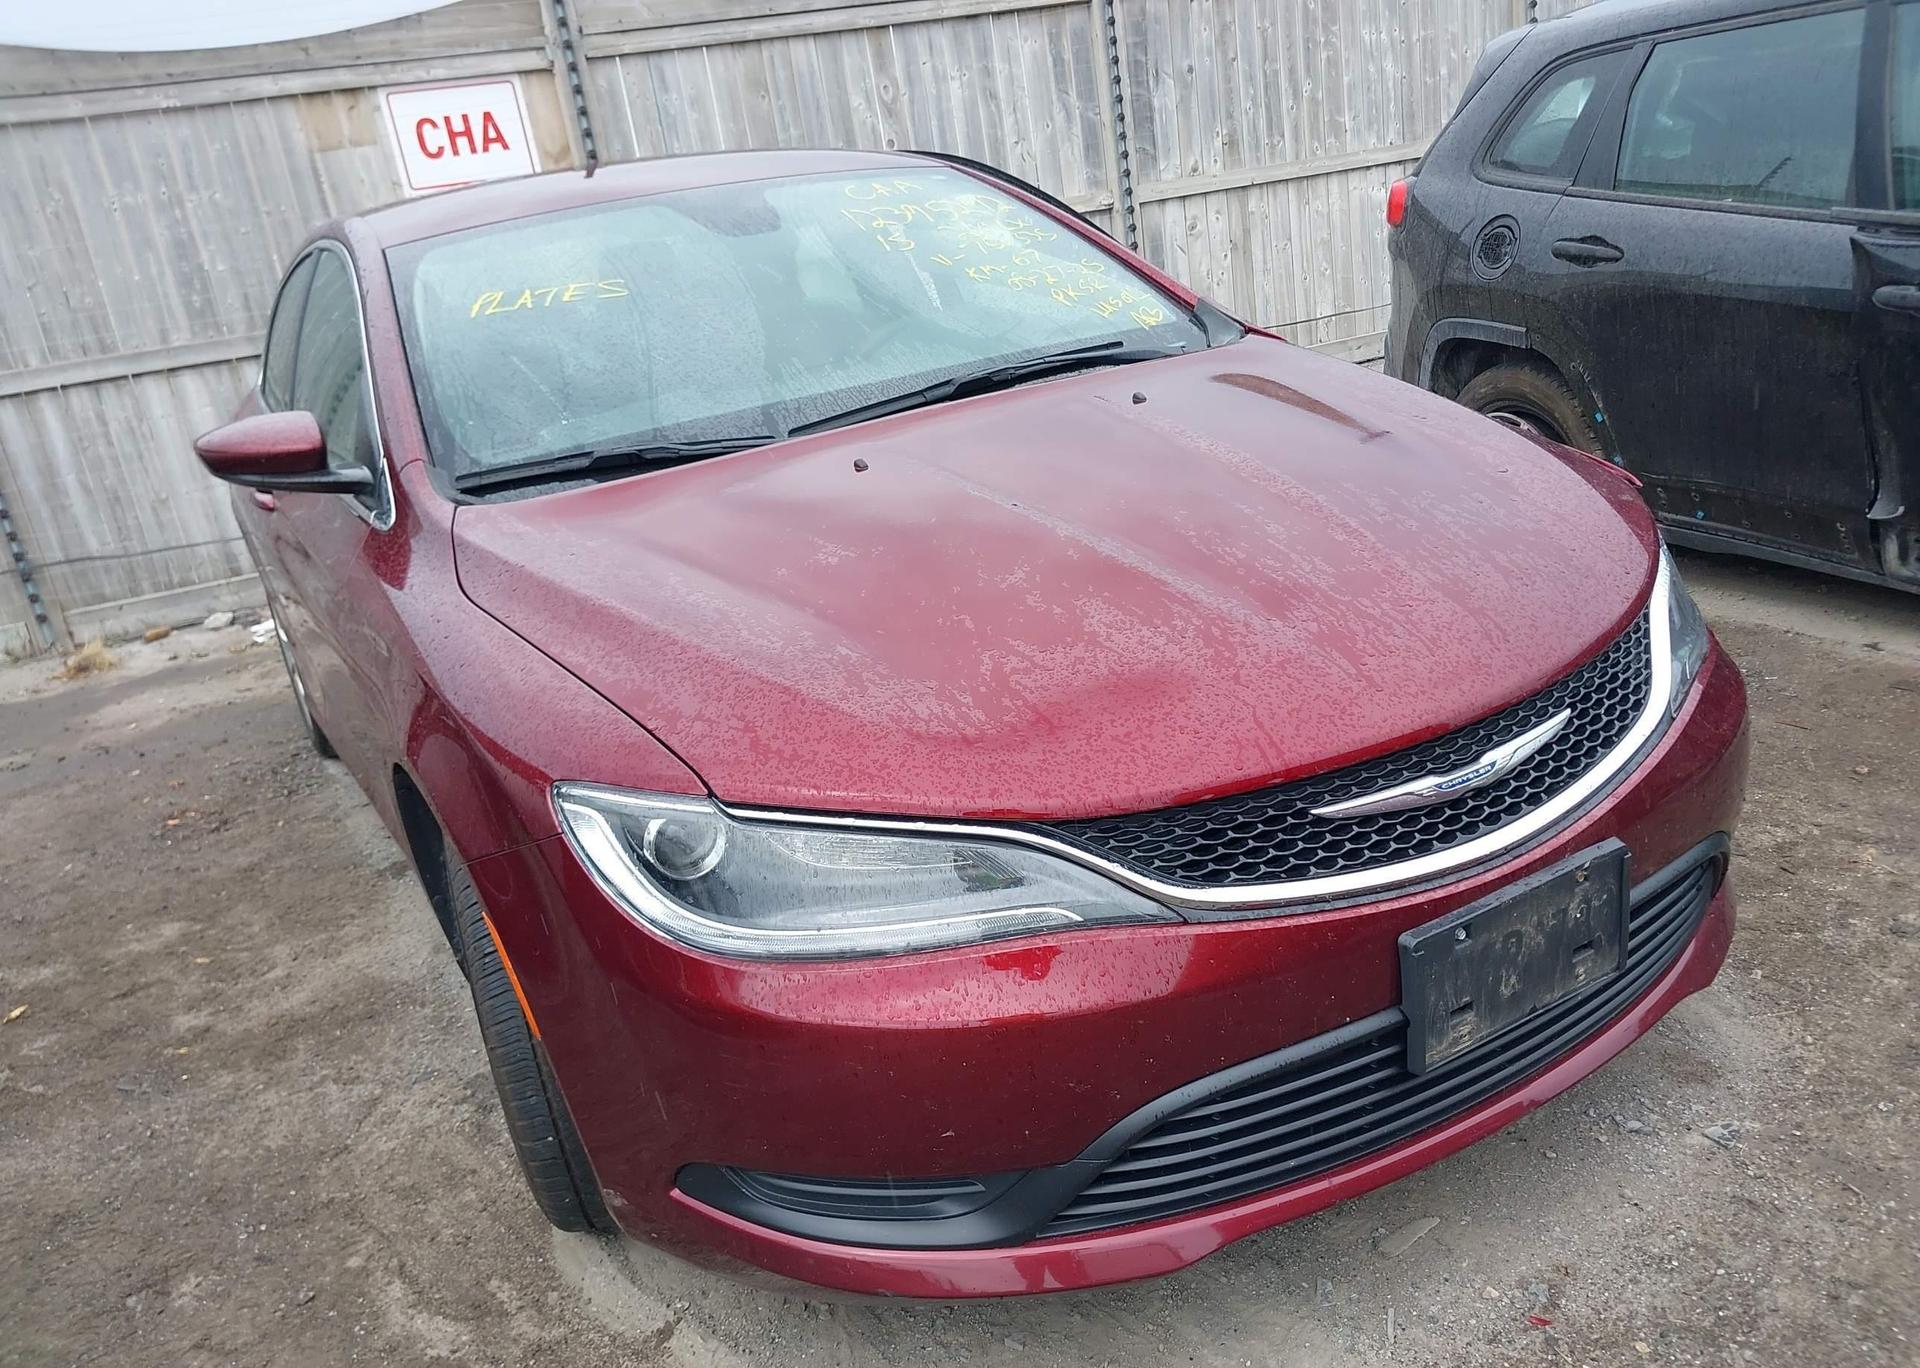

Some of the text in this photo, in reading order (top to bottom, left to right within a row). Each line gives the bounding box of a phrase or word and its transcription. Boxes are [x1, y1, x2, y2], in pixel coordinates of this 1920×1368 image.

[416, 111, 510, 159] CHA
[469, 279, 630, 318] PLATES
[1441, 764, 1493, 790] CHRYSLER
